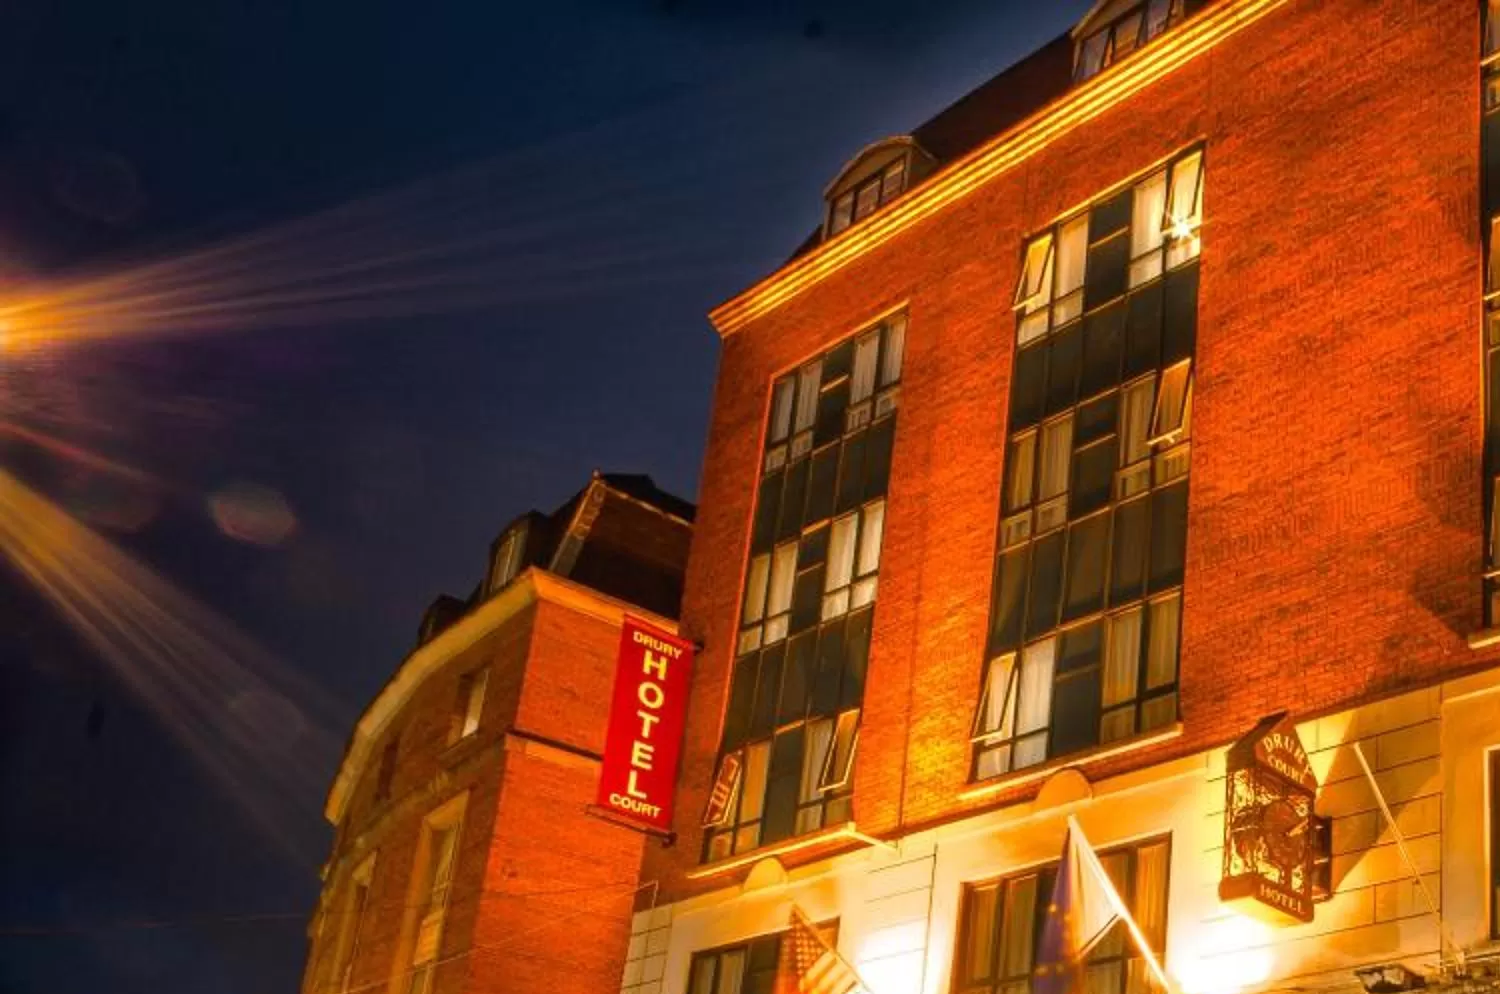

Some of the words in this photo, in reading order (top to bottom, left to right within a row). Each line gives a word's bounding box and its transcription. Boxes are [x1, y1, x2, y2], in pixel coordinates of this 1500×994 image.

[633, 631, 682, 659] DRURY
[627, 650, 668, 799] HOTEL
[609, 793, 661, 818] COURT
[1260, 884, 1305, 914] HOTEL
